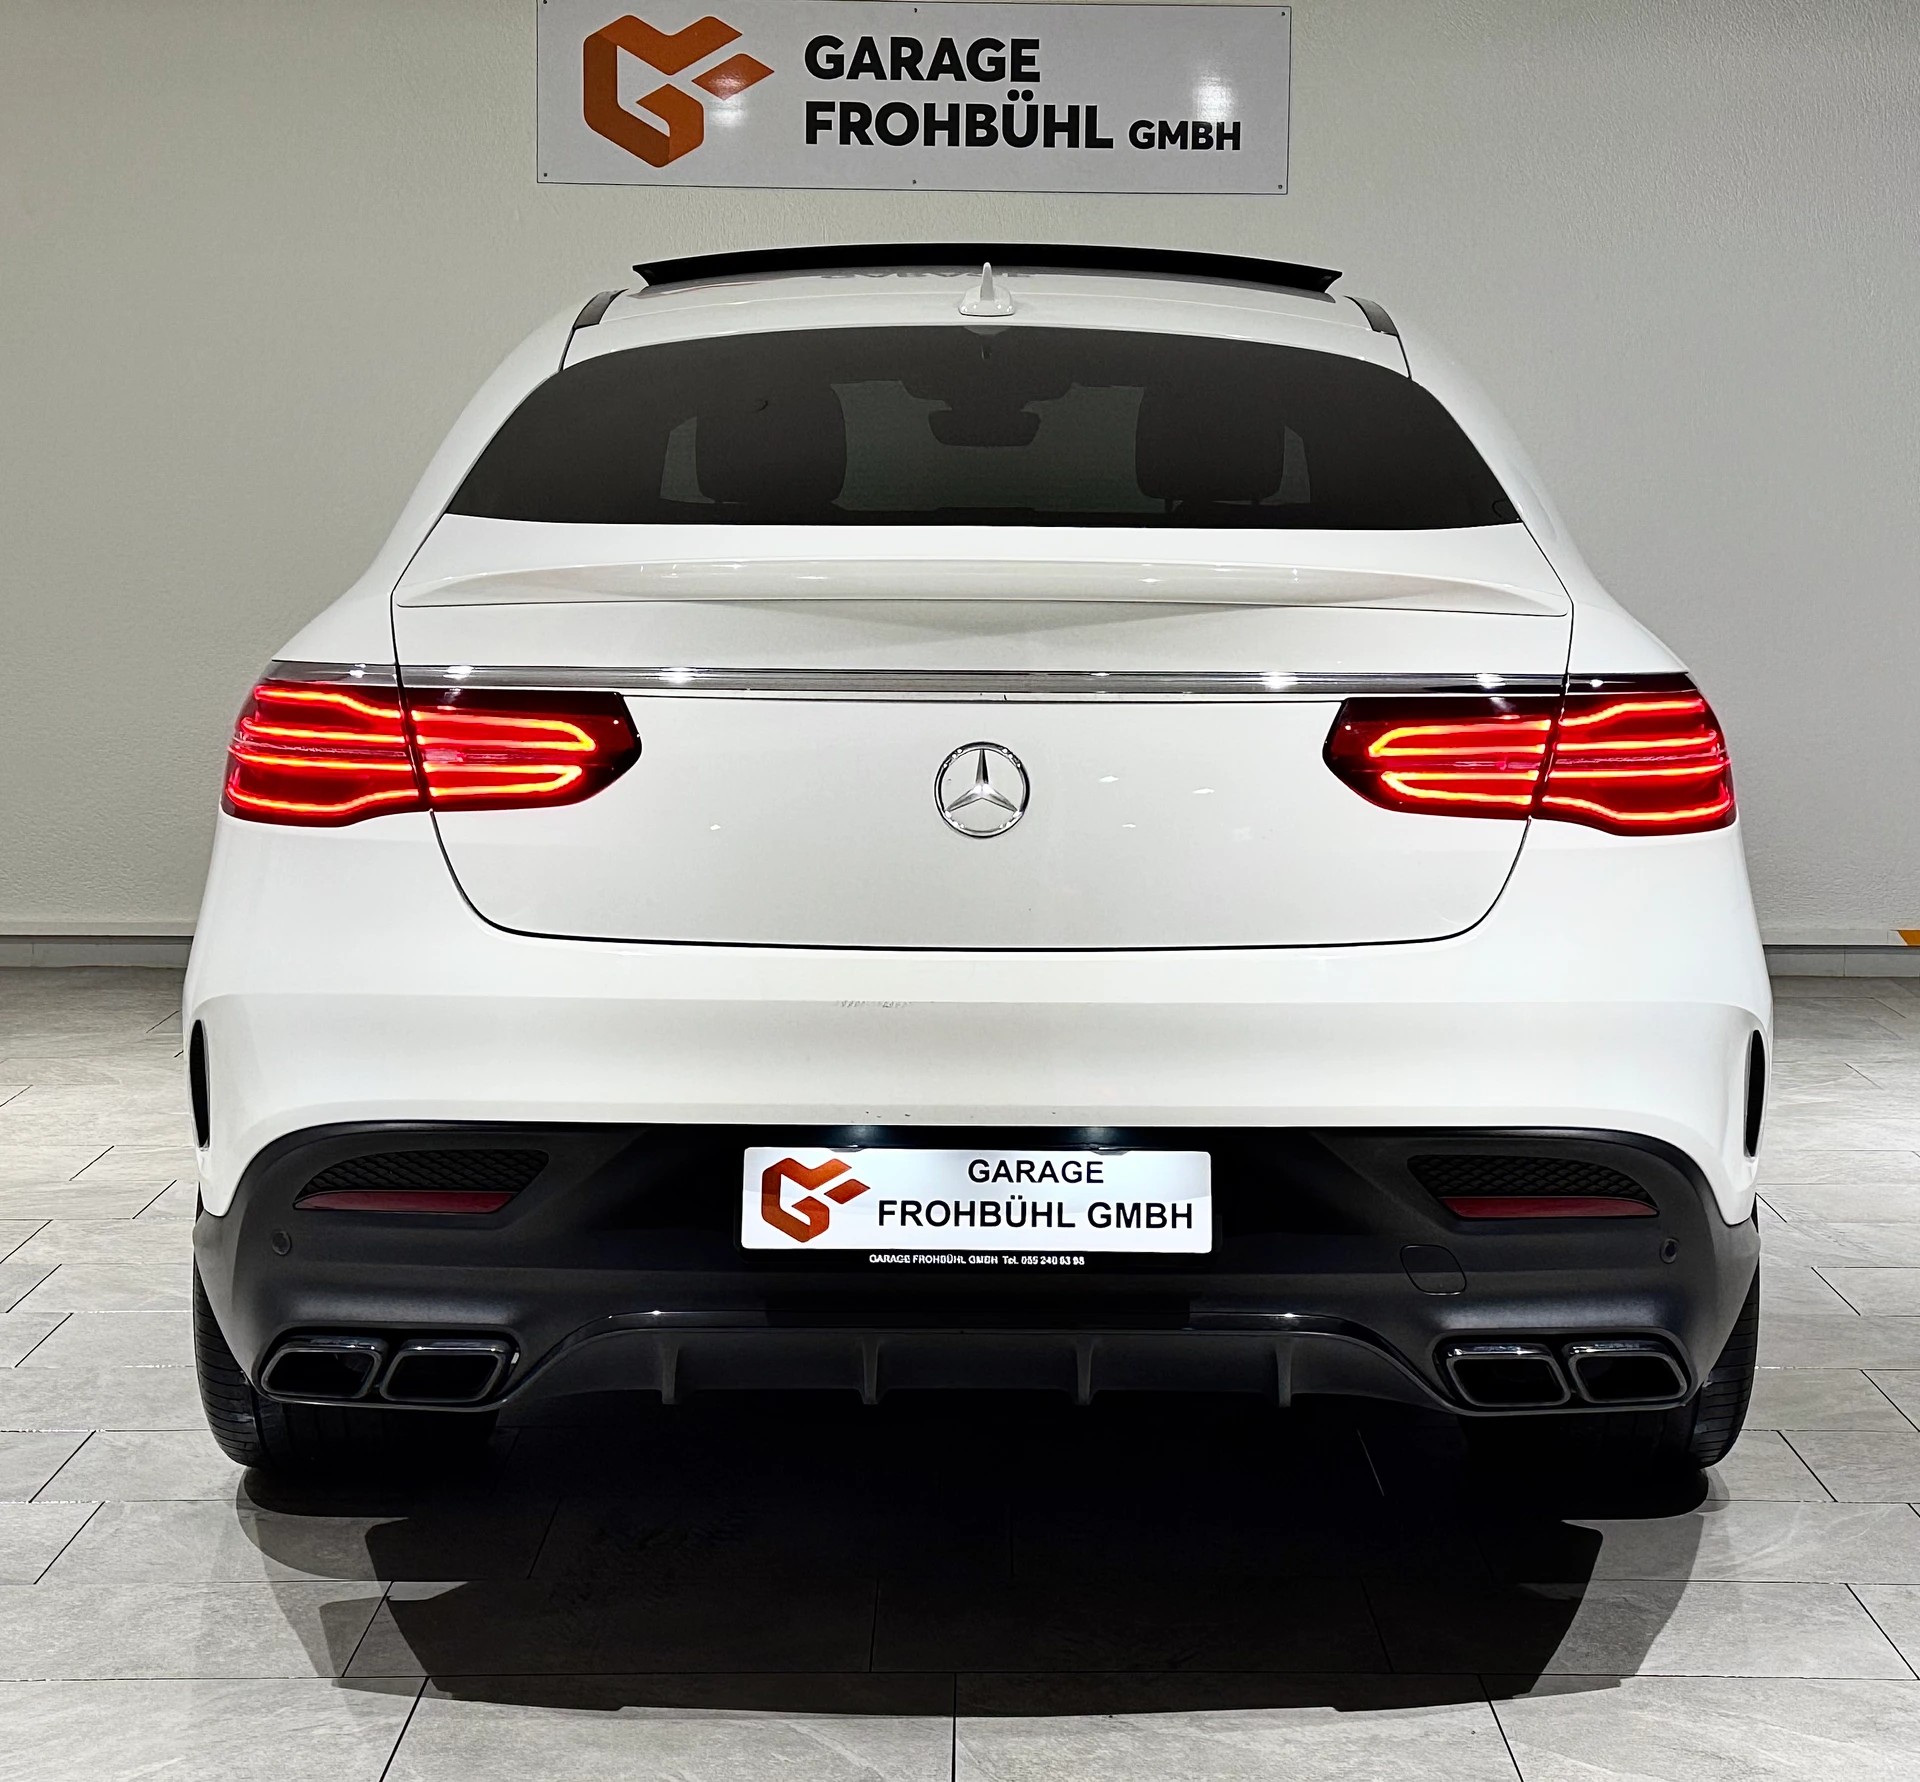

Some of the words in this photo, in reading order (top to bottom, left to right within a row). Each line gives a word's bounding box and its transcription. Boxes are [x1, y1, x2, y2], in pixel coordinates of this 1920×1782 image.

[805, 35, 1040, 82] GARAGE
[806, 89, 1114, 149] FROHBÜHL
[1129, 120, 1241, 151] GMBH
[968, 1159, 1104, 1184] GARAGE
[879, 1195, 1076, 1228] FROHBÜHL
[1088, 1202, 1192, 1229] GMBH
[869, 1254, 911, 1264] GARAGE
[968, 1255, 999, 1265] GMBH
